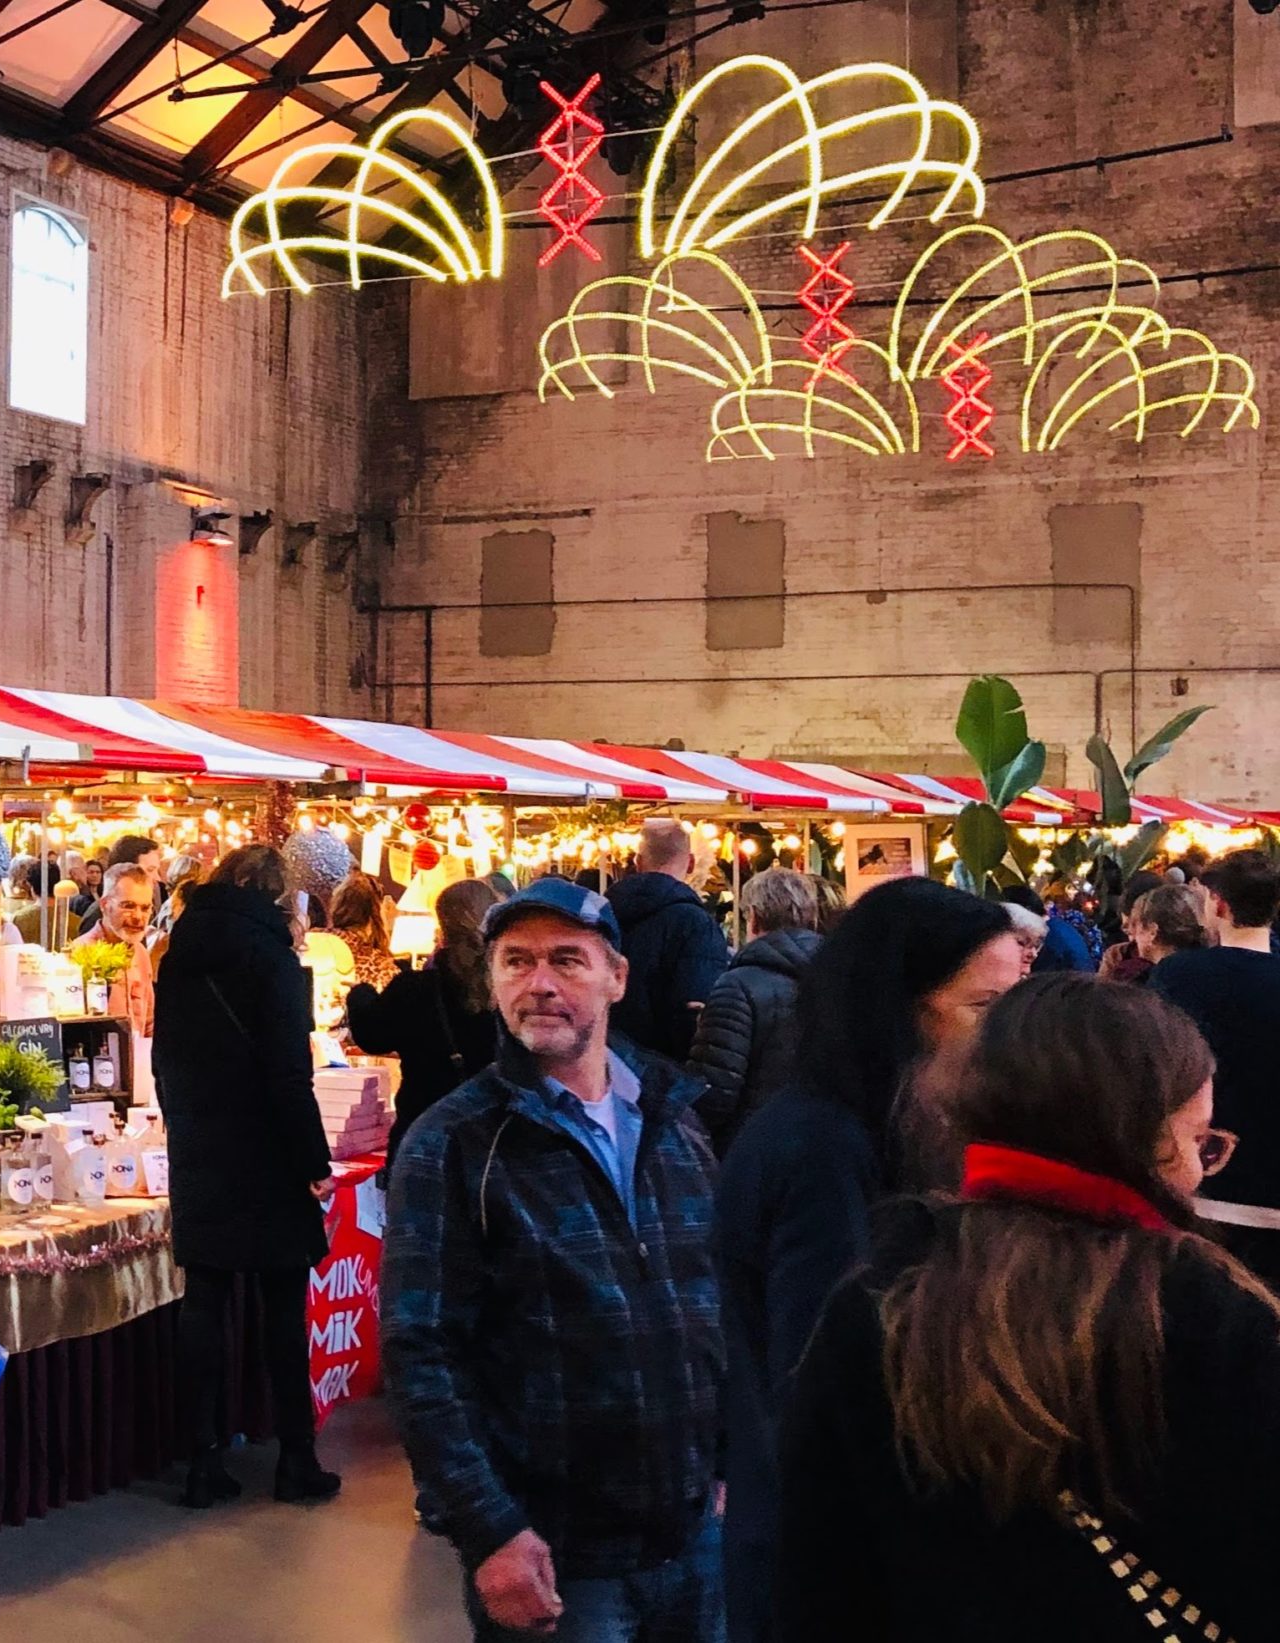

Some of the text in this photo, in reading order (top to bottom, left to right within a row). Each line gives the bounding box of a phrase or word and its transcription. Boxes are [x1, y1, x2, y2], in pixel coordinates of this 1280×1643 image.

[19, 1039, 42, 1055] GIN
[309, 1254, 364, 1307] MOK
[310, 1360, 360, 1414] MAK
